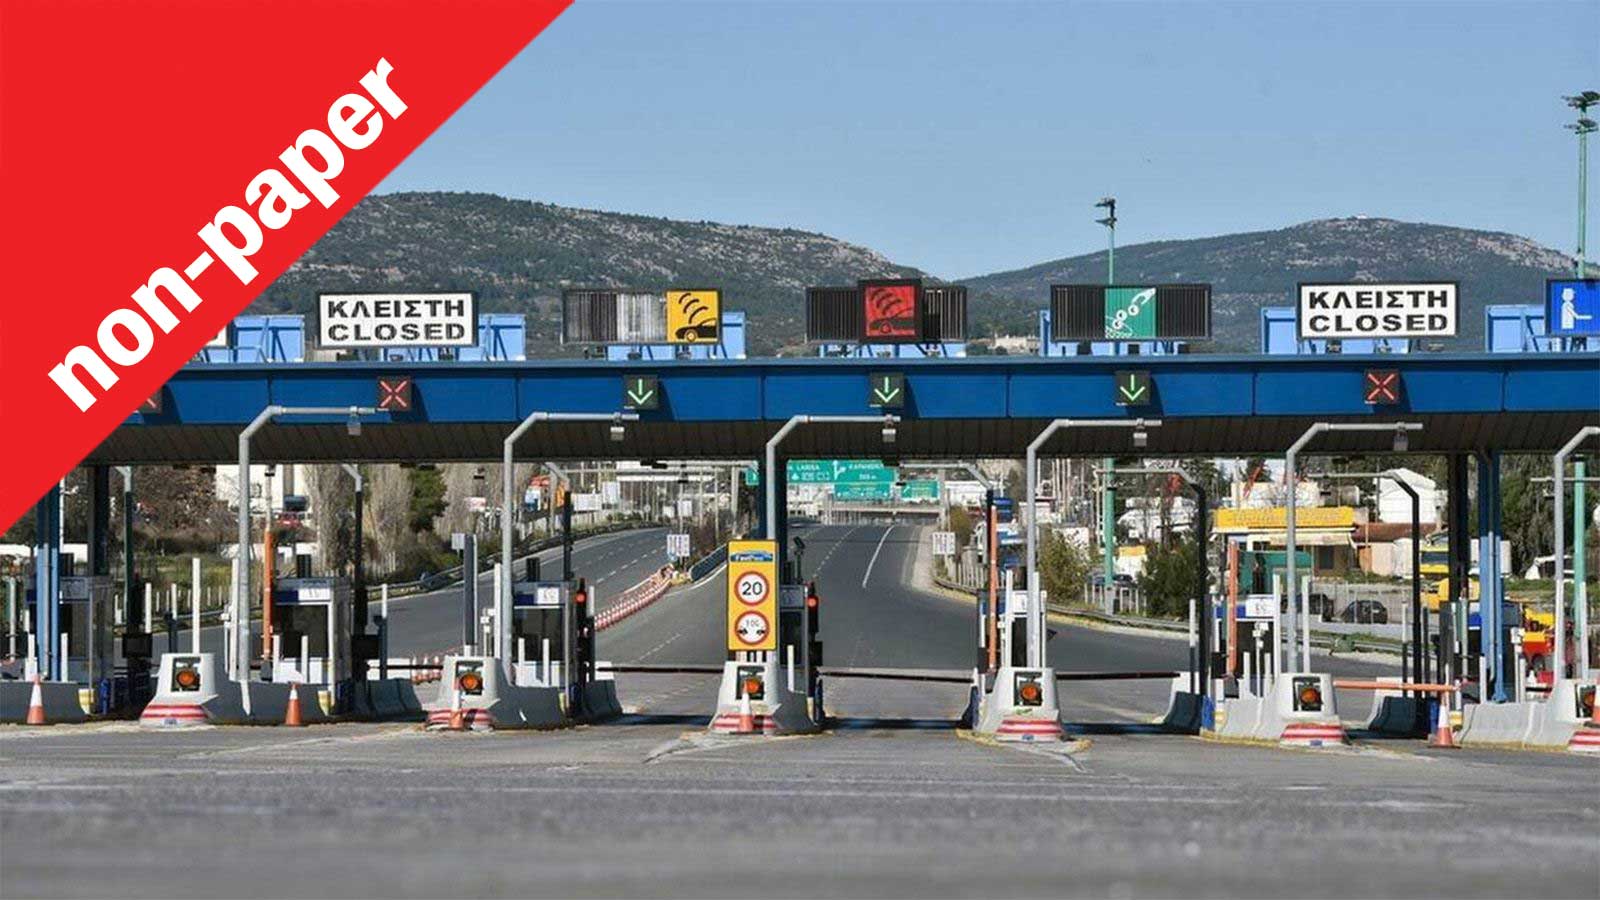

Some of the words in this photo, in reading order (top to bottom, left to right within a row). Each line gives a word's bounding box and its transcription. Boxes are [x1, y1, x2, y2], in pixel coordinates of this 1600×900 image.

[328, 299, 465, 318] ΚΛΕΙΣΤΗ
[1309, 291, 1448, 309] ΚΛΕΙΣΤΗ
[328, 323, 465, 341] CLOSED
[1309, 314, 1448, 332] CLOSED
[742, 582, 763, 596] 20
